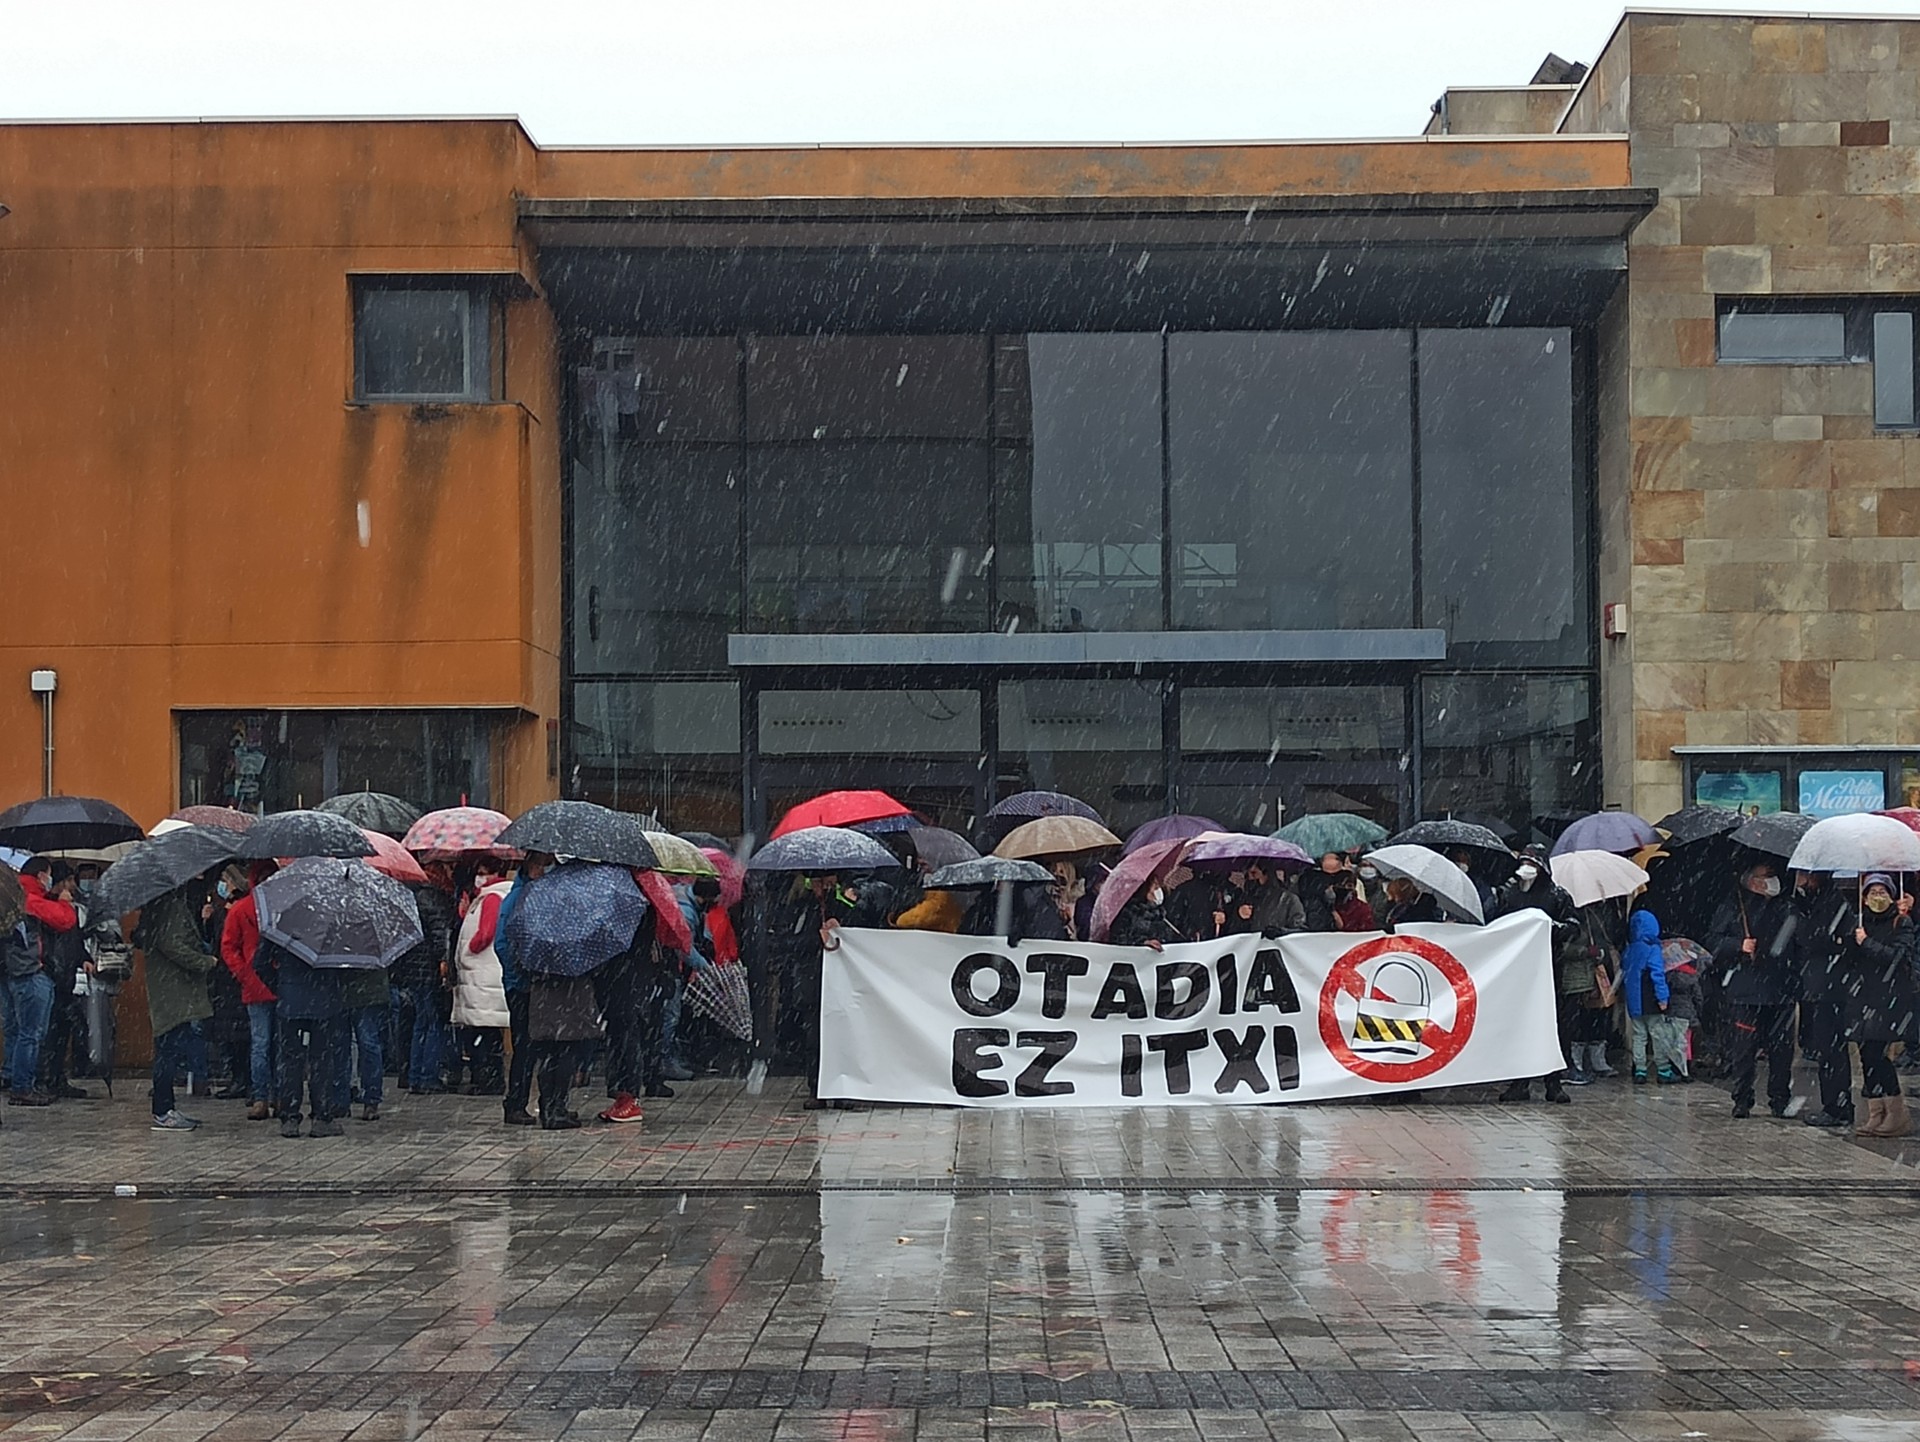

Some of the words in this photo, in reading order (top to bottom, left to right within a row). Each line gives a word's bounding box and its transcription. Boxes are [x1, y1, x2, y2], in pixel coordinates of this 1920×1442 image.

[1800, 784, 1884, 810] Maman
[1836, 777, 1875, 795] Petite
[951, 948, 1301, 1020] OTADIA
[952, 1028, 1078, 1097] EZ
[1121, 1025, 1300, 1097] ITXI
